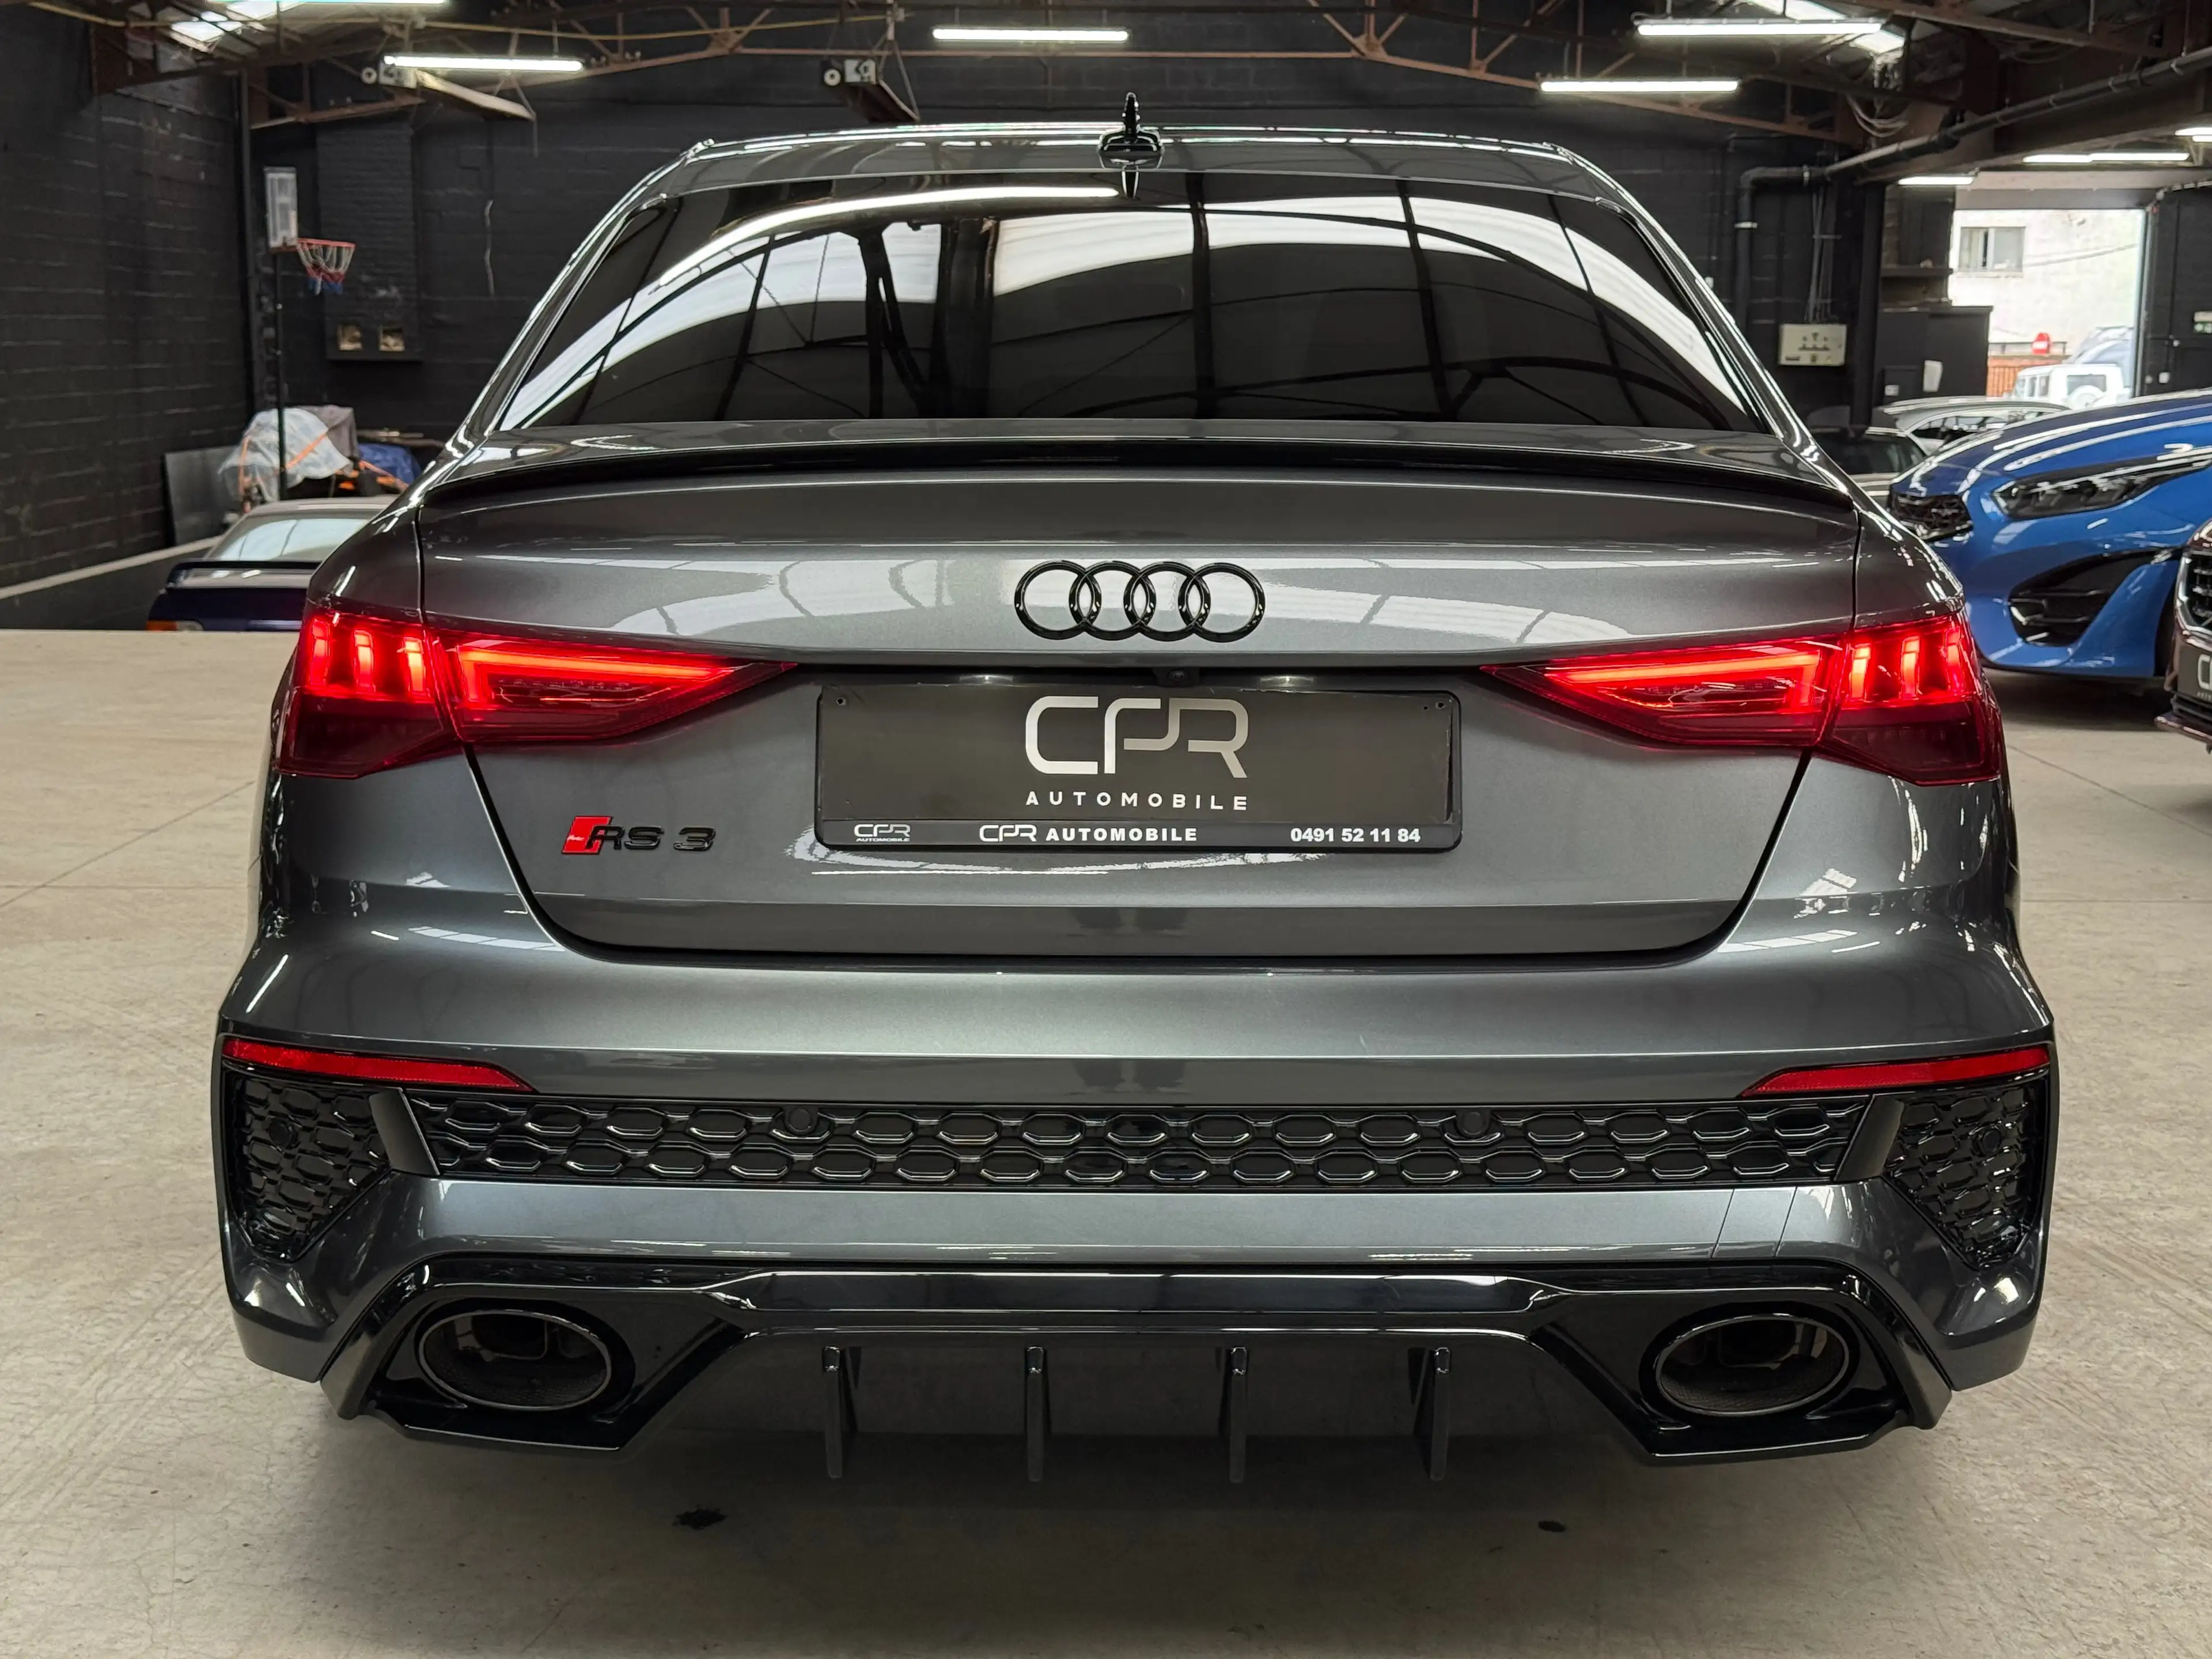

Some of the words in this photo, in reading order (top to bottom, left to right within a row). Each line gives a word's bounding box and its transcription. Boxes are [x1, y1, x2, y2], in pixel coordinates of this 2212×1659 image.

[1025, 695, 1249, 778] CPR
[1025, 791, 1247, 810] AUTOMOBILE
[582, 824, 665, 851] RS
[673, 825, 717, 851] 3
[854, 824, 911, 837] CPR
[979, 824, 1037, 842] CPR
[1046, 827, 1198, 842] AUTOMOBILE
[1290, 827, 1335, 842] 0491
[1341, 828, 1365, 842] 52
[1370, 828, 1391, 842] 11
[1397, 828, 1421, 843] 84
